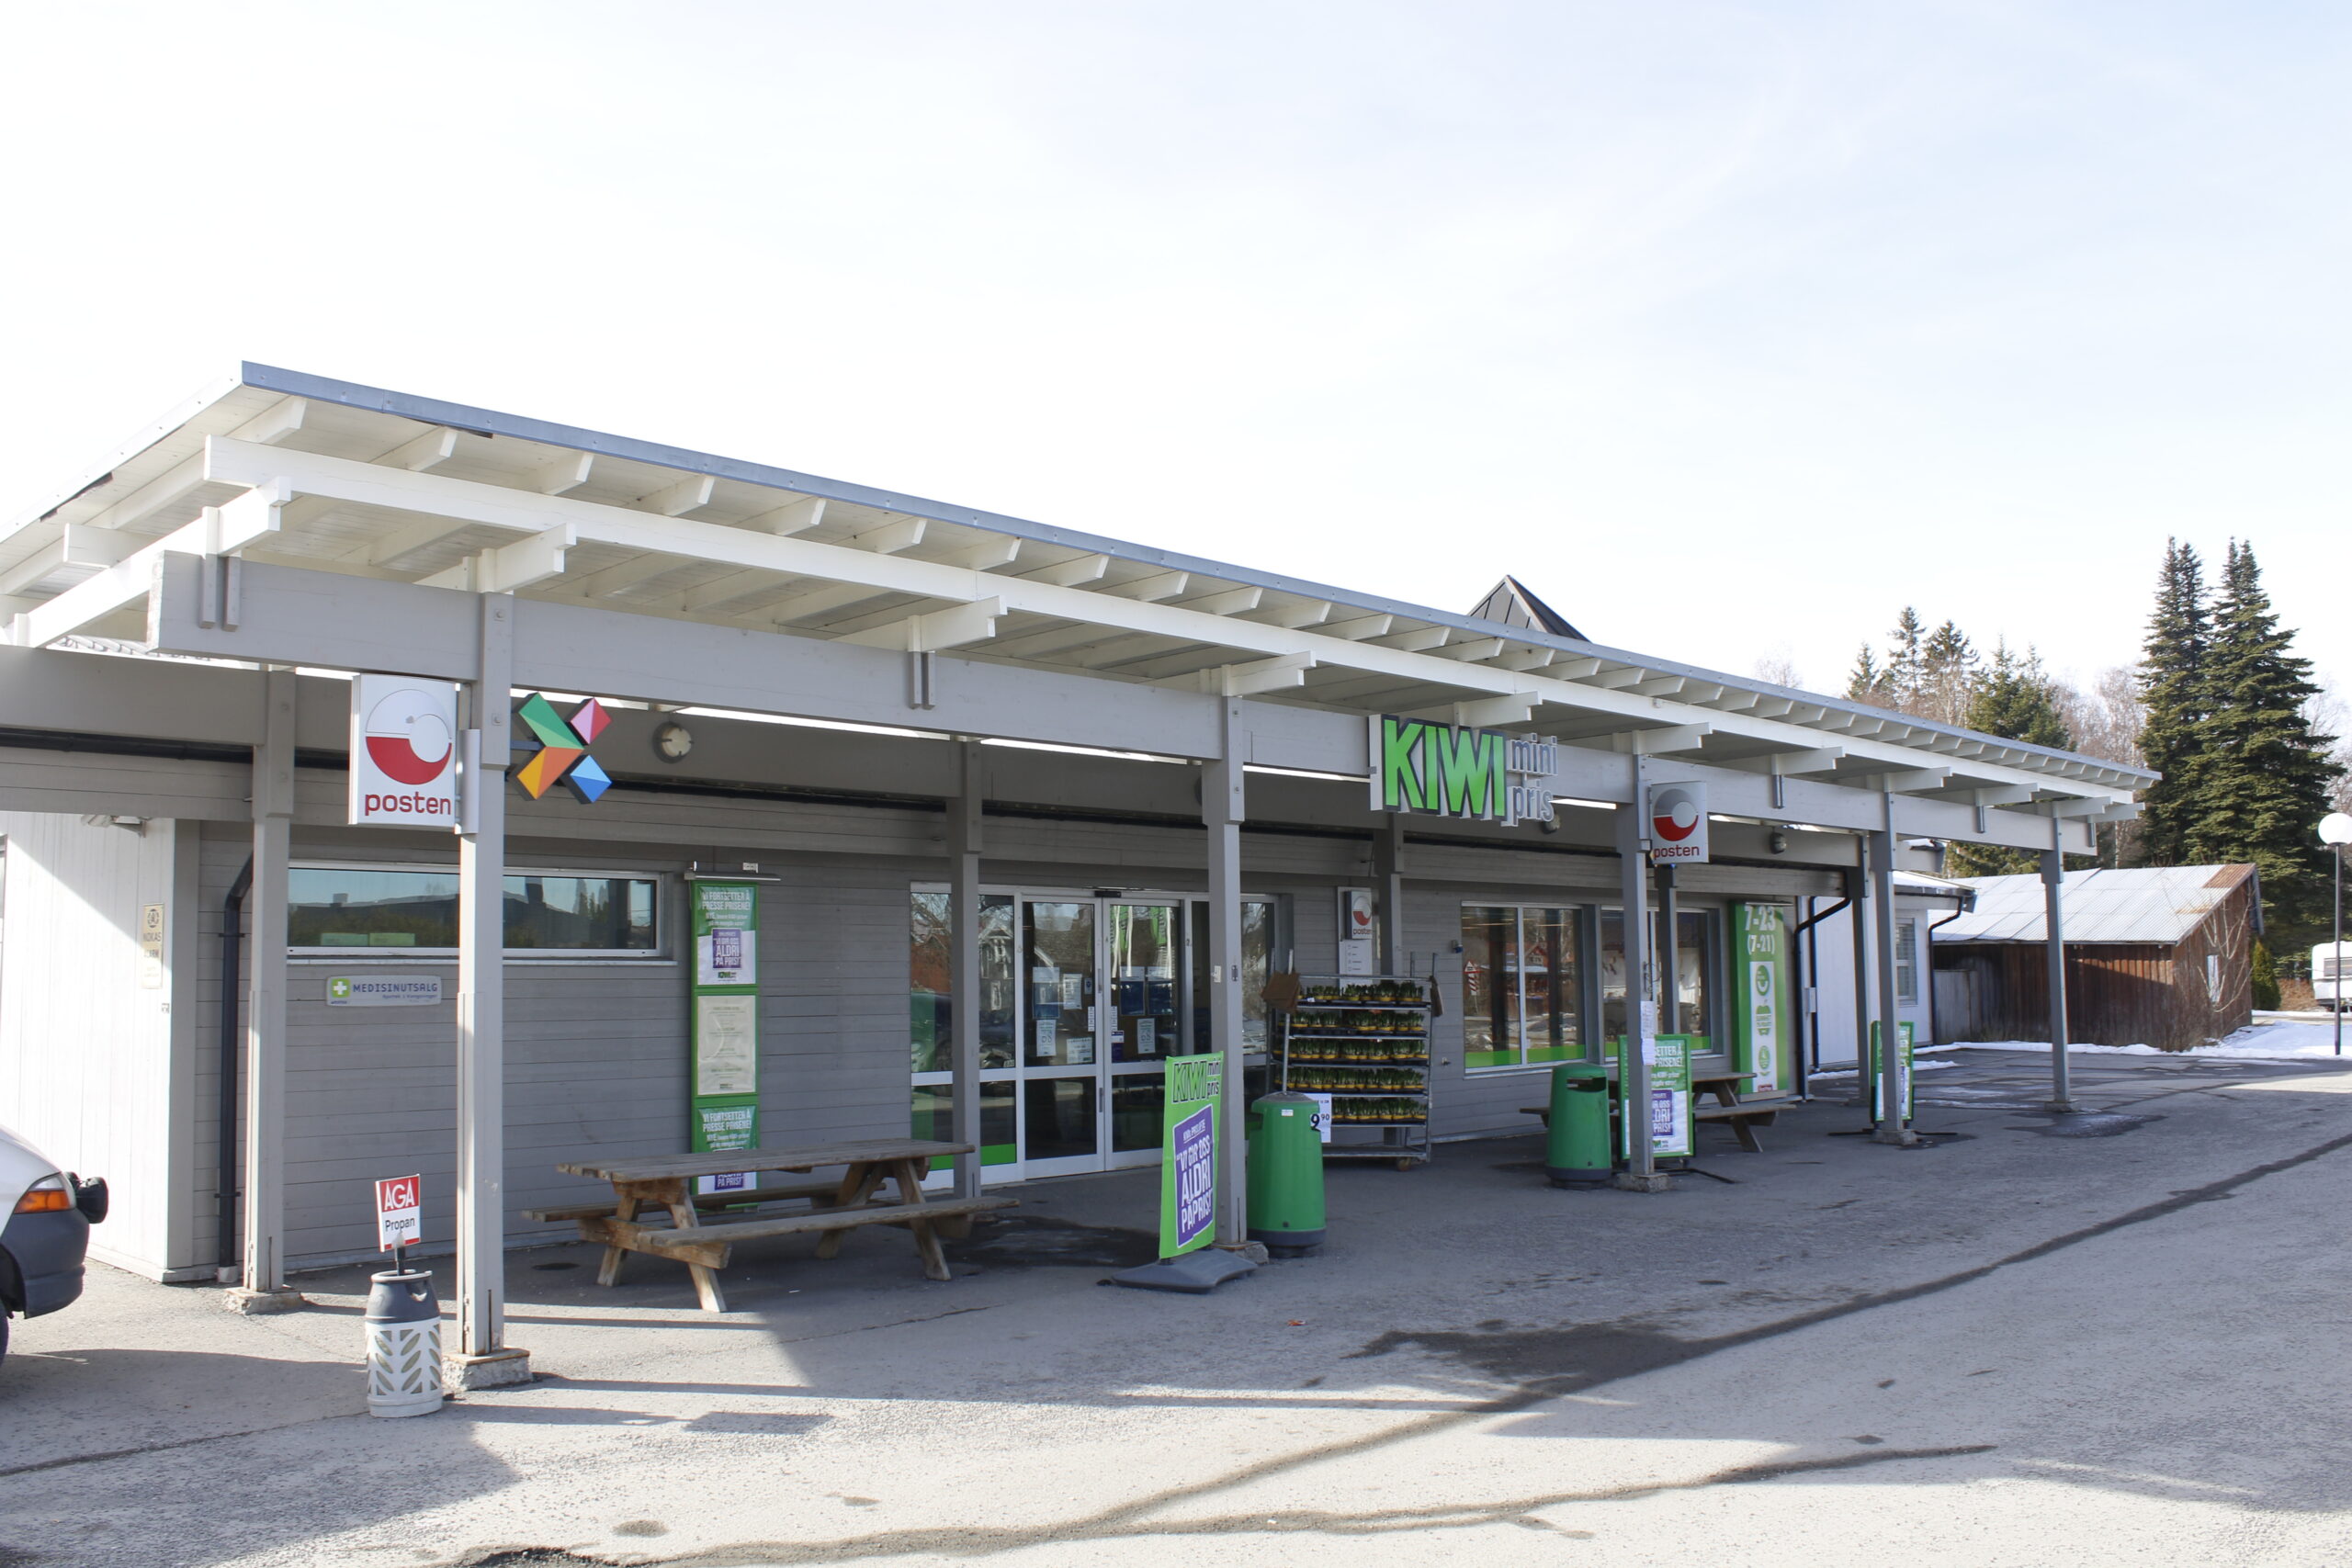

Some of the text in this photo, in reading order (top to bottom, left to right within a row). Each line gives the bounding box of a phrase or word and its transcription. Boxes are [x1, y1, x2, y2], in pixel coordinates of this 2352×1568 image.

[1511, 733, 1558, 775] mini
[1381, 715, 1507, 820] KIWI
[365, 791, 451, 816] posten
[1511, 779, 1554, 827] pris
[1654, 844, 1700, 860] posten
[1745, 905, 1776, 931] 7-23
[716, 945, 740, 956] ALDRI
[1747, 934, 1775, 955] (7-21)
[353, 983, 438, 993] MEDISINUTSALG
[1172, 1059, 1207, 1103] KIWI
[1206, 1078, 1219, 1100] pris
[702, 1122, 726, 1132] PRESSE
[1652, 1109, 1670, 1122] DRI
[1188, 1143, 1198, 1167] GIR
[1198, 1134, 1211, 1159] OSS
[1181, 1155, 1211, 1207] ALDRI
[383, 1179, 415, 1211] AGA
[385, 1217, 415, 1232] Propan
